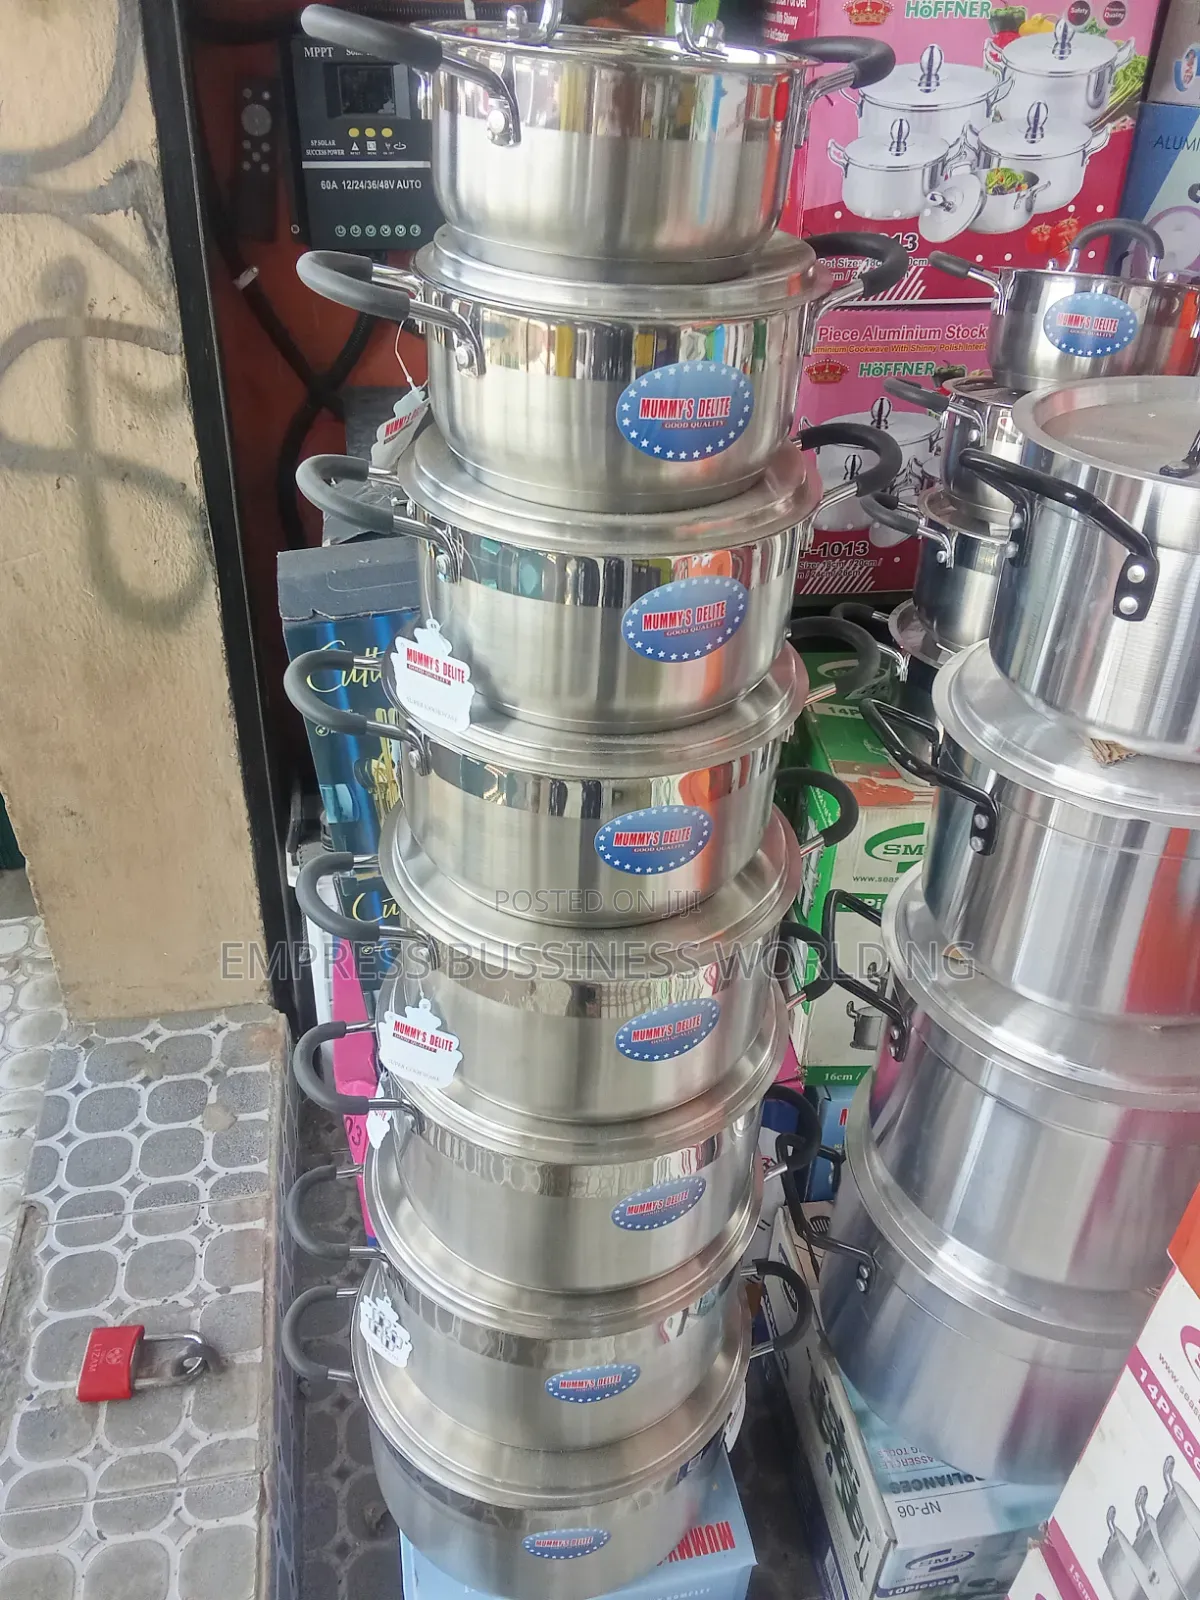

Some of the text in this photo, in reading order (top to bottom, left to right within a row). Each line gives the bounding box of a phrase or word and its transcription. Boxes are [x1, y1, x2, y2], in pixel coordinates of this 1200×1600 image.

[1070, 7, 1088, 15] Safety
[1104, 11, 1124, 19] Quality
[304, 47, 333, 58] MPPT
[320, 179, 422, 190] 60A 12/24/36/48V AUTO
[818, 323, 988, 342] Piece Aluminium Stock
[1092, 316, 1119, 333] DELITE
[812, 345, 847, 353] uminium
[639, 396, 732, 420] MUMMY'S DELITE
[664, 420, 725, 429] GOOD QUALITY
[642, 600, 727, 632] MUMMY'S DELITE
[666, 621, 724, 637] GOOD QUALITY
[406, 647, 465, 684] MUMMY'S DELITE
[613, 826, 692, 847] MUMMY'S DELITE
[393, 1020, 454, 1052] MUMMY'S DELITE
[631, 1014, 702, 1043] MUMMY'S DELITE
[824, 1072, 853, 1081] 16cm
[625, 1198, 664, 1216] MUMMY'S
[897, 1500, 942, 1518] NP-06
